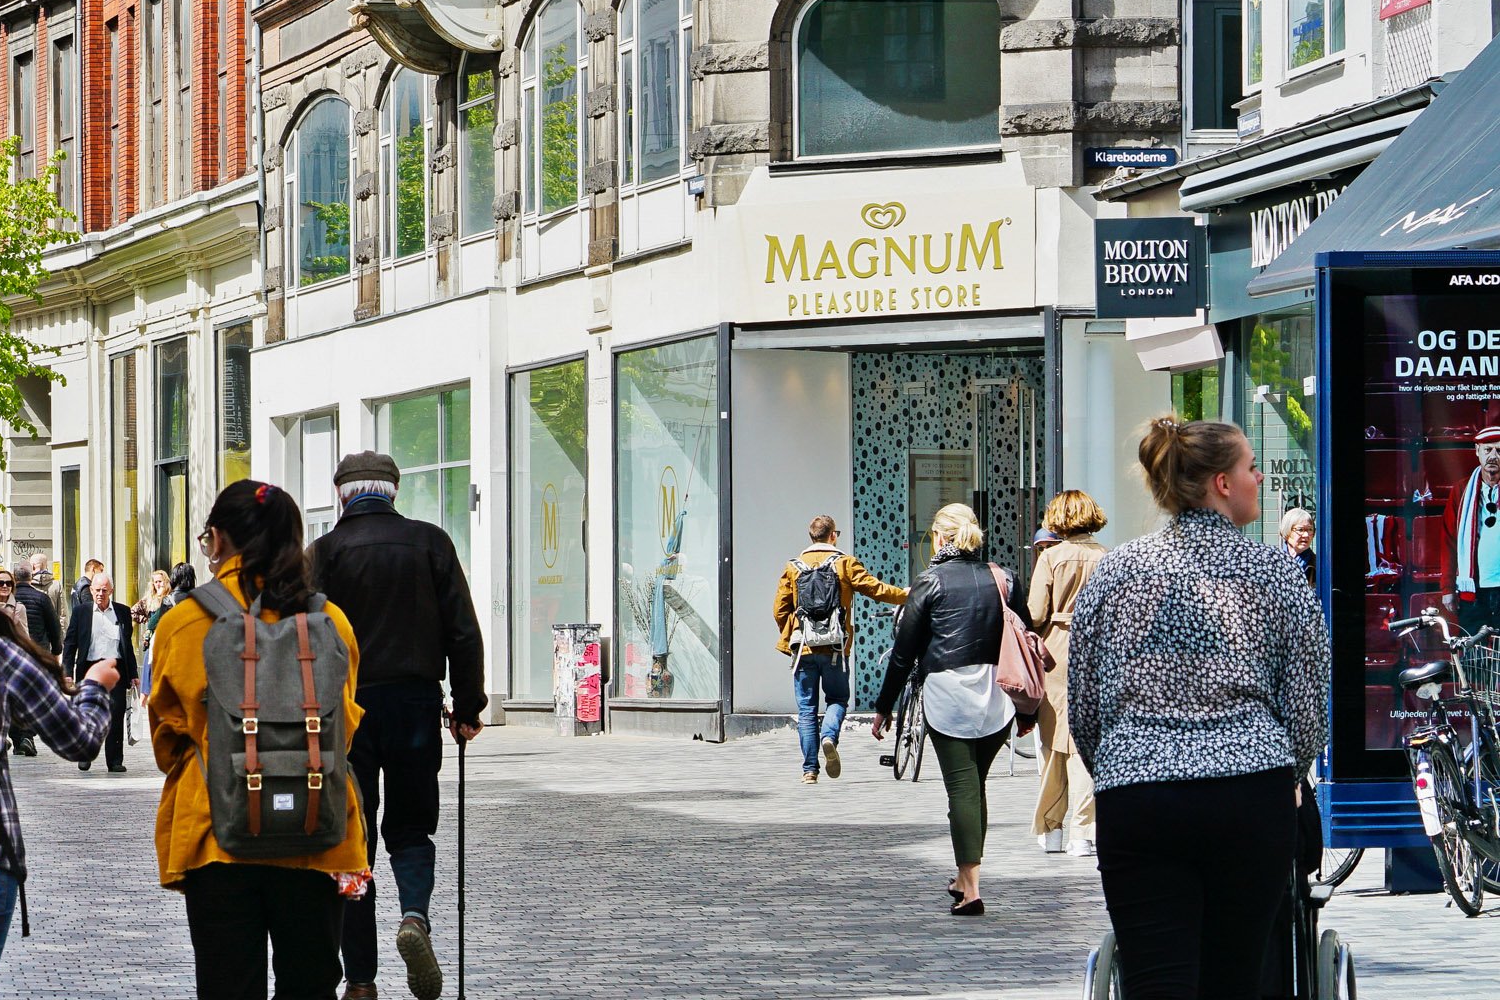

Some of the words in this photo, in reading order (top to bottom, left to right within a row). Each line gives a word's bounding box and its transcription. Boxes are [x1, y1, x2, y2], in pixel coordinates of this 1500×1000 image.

[1095, 151, 1167, 163] Klareboderne
[765, 218, 1005, 283] MAGNUM
[1103, 239, 1189, 261] MOLTON
[1104, 263, 1189, 284] BROWN
[1449, 274, 1474, 286] AFA
[788, 288, 897, 316] PLEASURE
[911, 283, 981, 310] STORE
[1120, 287, 1174, 296] LONDON
[1417, 329, 1457, 351] OG
[1467, 329, 1500, 350] DE
[1395, 355, 1500, 378] DAAAN
[1398, 384, 1413, 392] hvor
[1471, 384, 1488, 392] langt
[1446, 394, 1455, 402] og
[1465, 393, 1491, 401] fattigste
[1389, 709, 1428, 720] Uligheden
